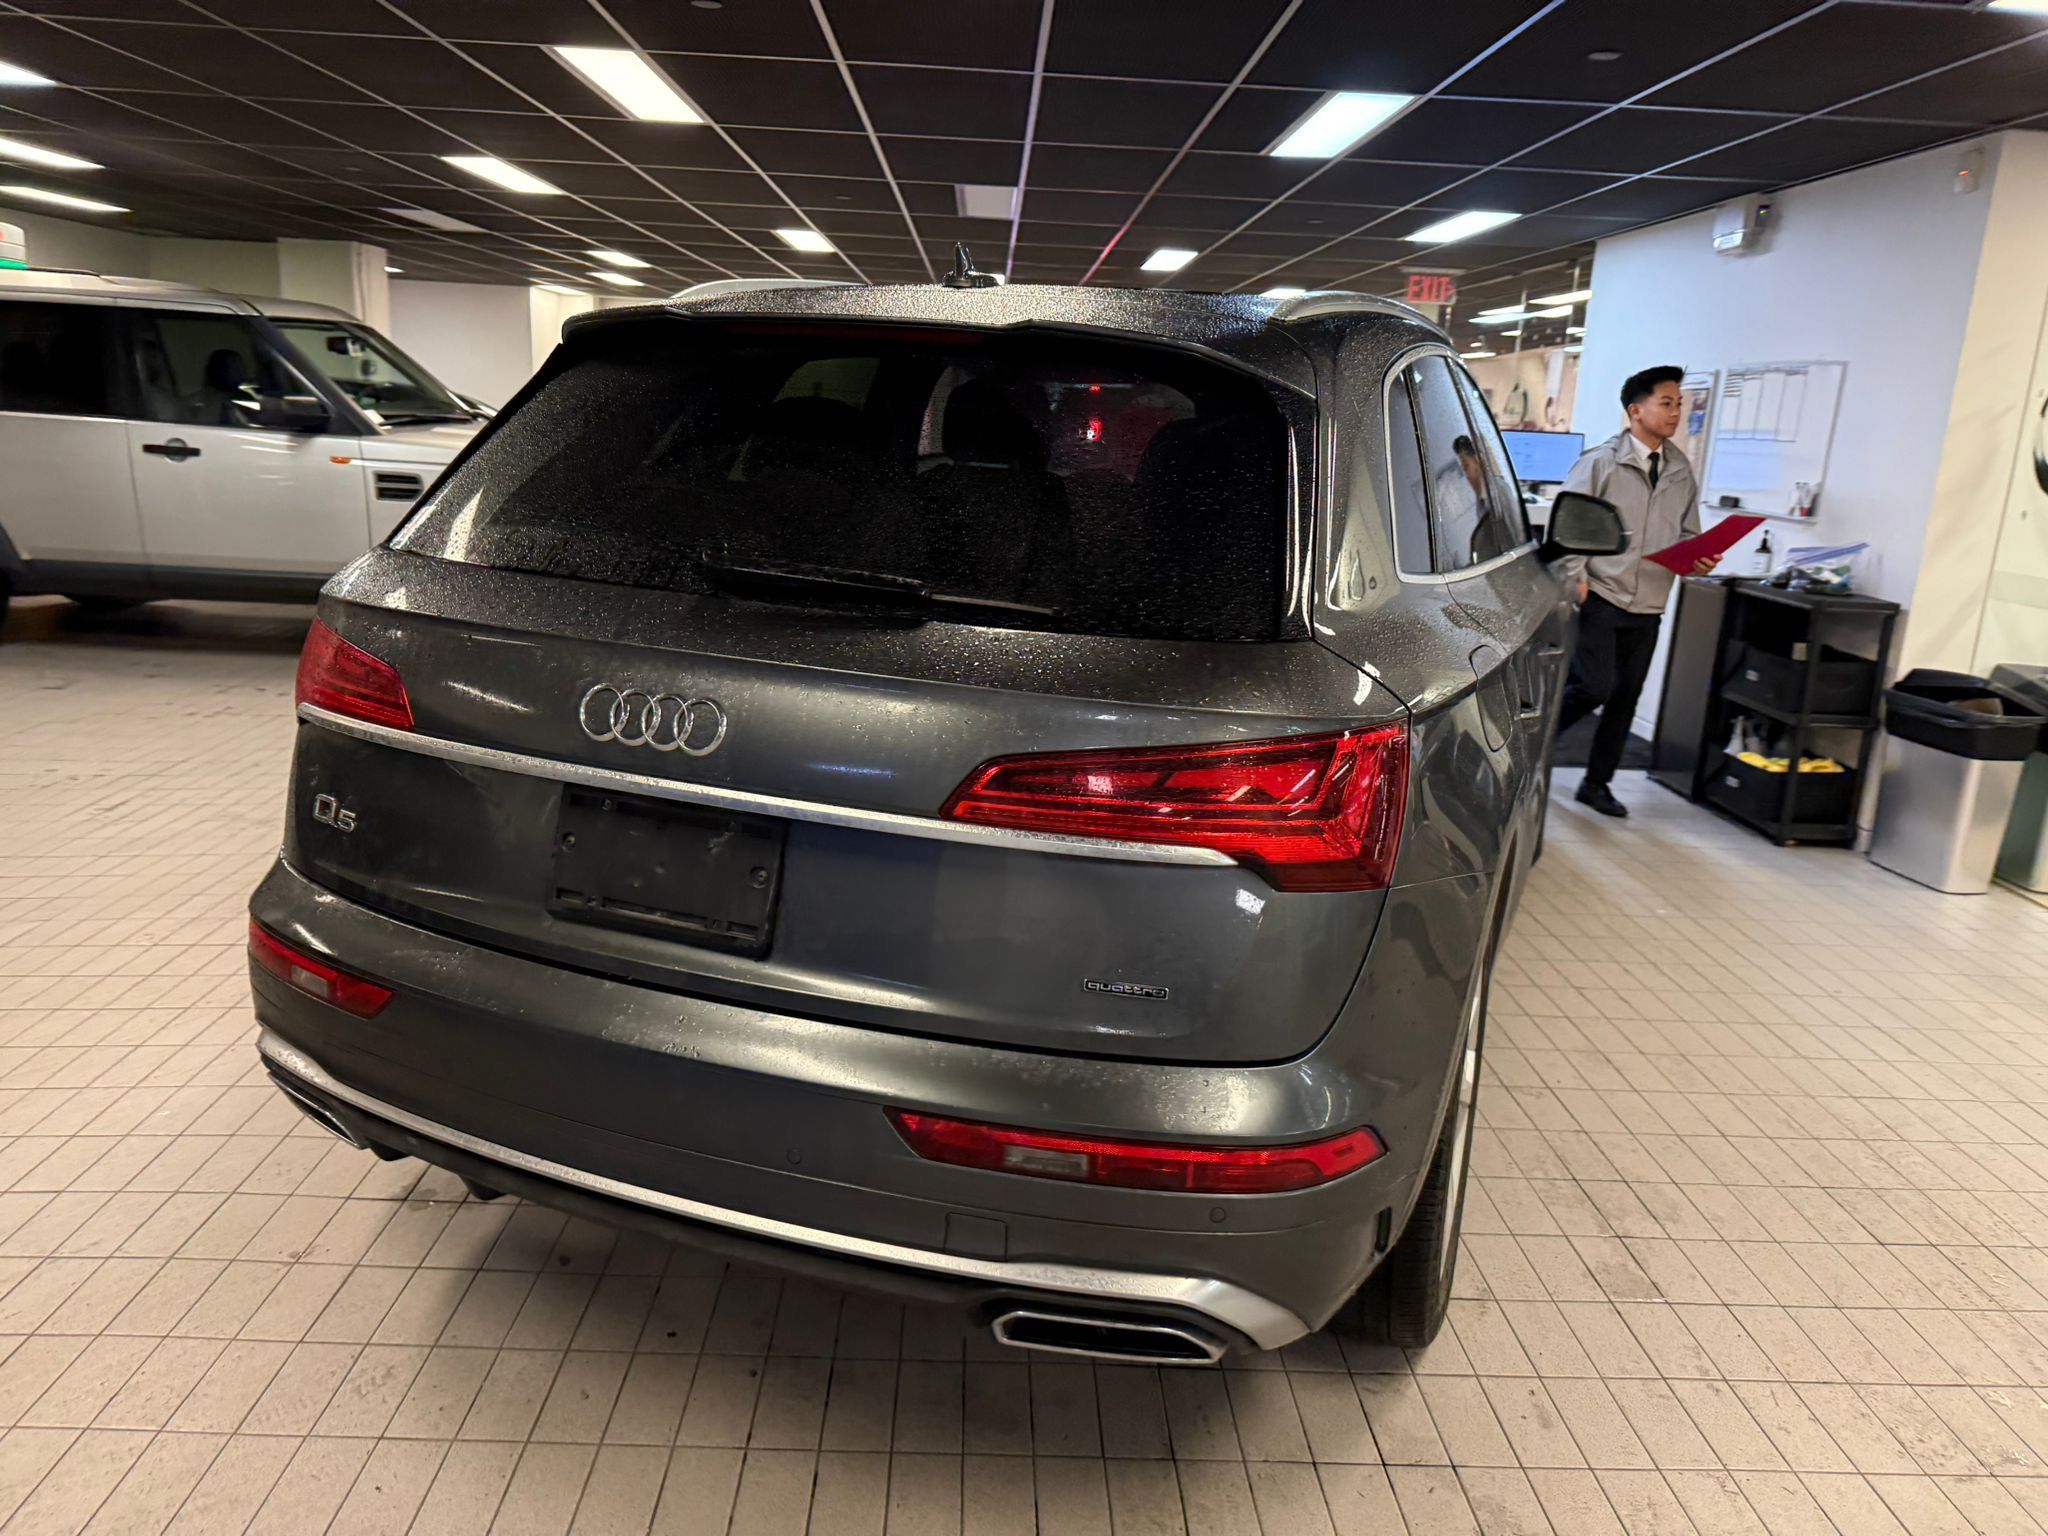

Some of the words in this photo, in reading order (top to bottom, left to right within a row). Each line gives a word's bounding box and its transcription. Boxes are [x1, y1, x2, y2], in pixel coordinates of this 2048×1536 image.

[1408, 275, 1451, 303] EXIT
[312, 793, 356, 833] Q5
[1086, 981, 1166, 998] quattro
